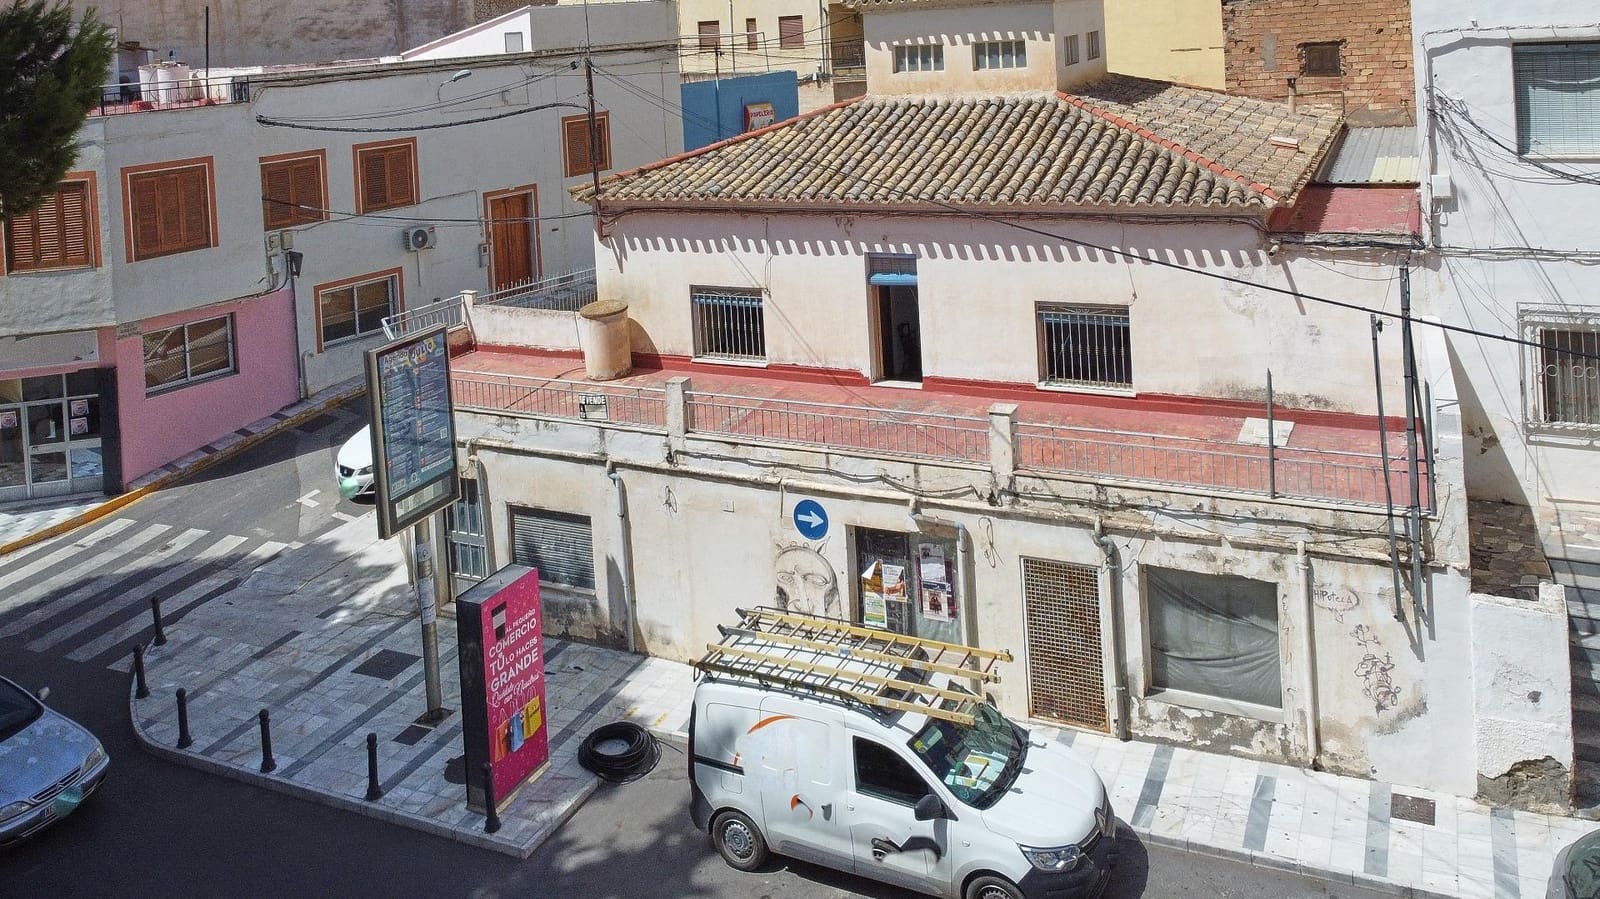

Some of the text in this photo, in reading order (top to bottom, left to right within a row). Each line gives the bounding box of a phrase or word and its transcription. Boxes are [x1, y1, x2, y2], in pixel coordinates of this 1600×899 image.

[384, 351, 408, 365] Agenda
[411, 342, 433, 359] JULIO
[586, 395, 606, 405] VENDE
[505, 608, 536, 634] AL PEQUEÑO
[489, 617, 537, 658] COMERCIO
[506, 653, 515, 665] LO
[516, 636, 538, 657] HACES
[490, 648, 538, 691] GRANDE
